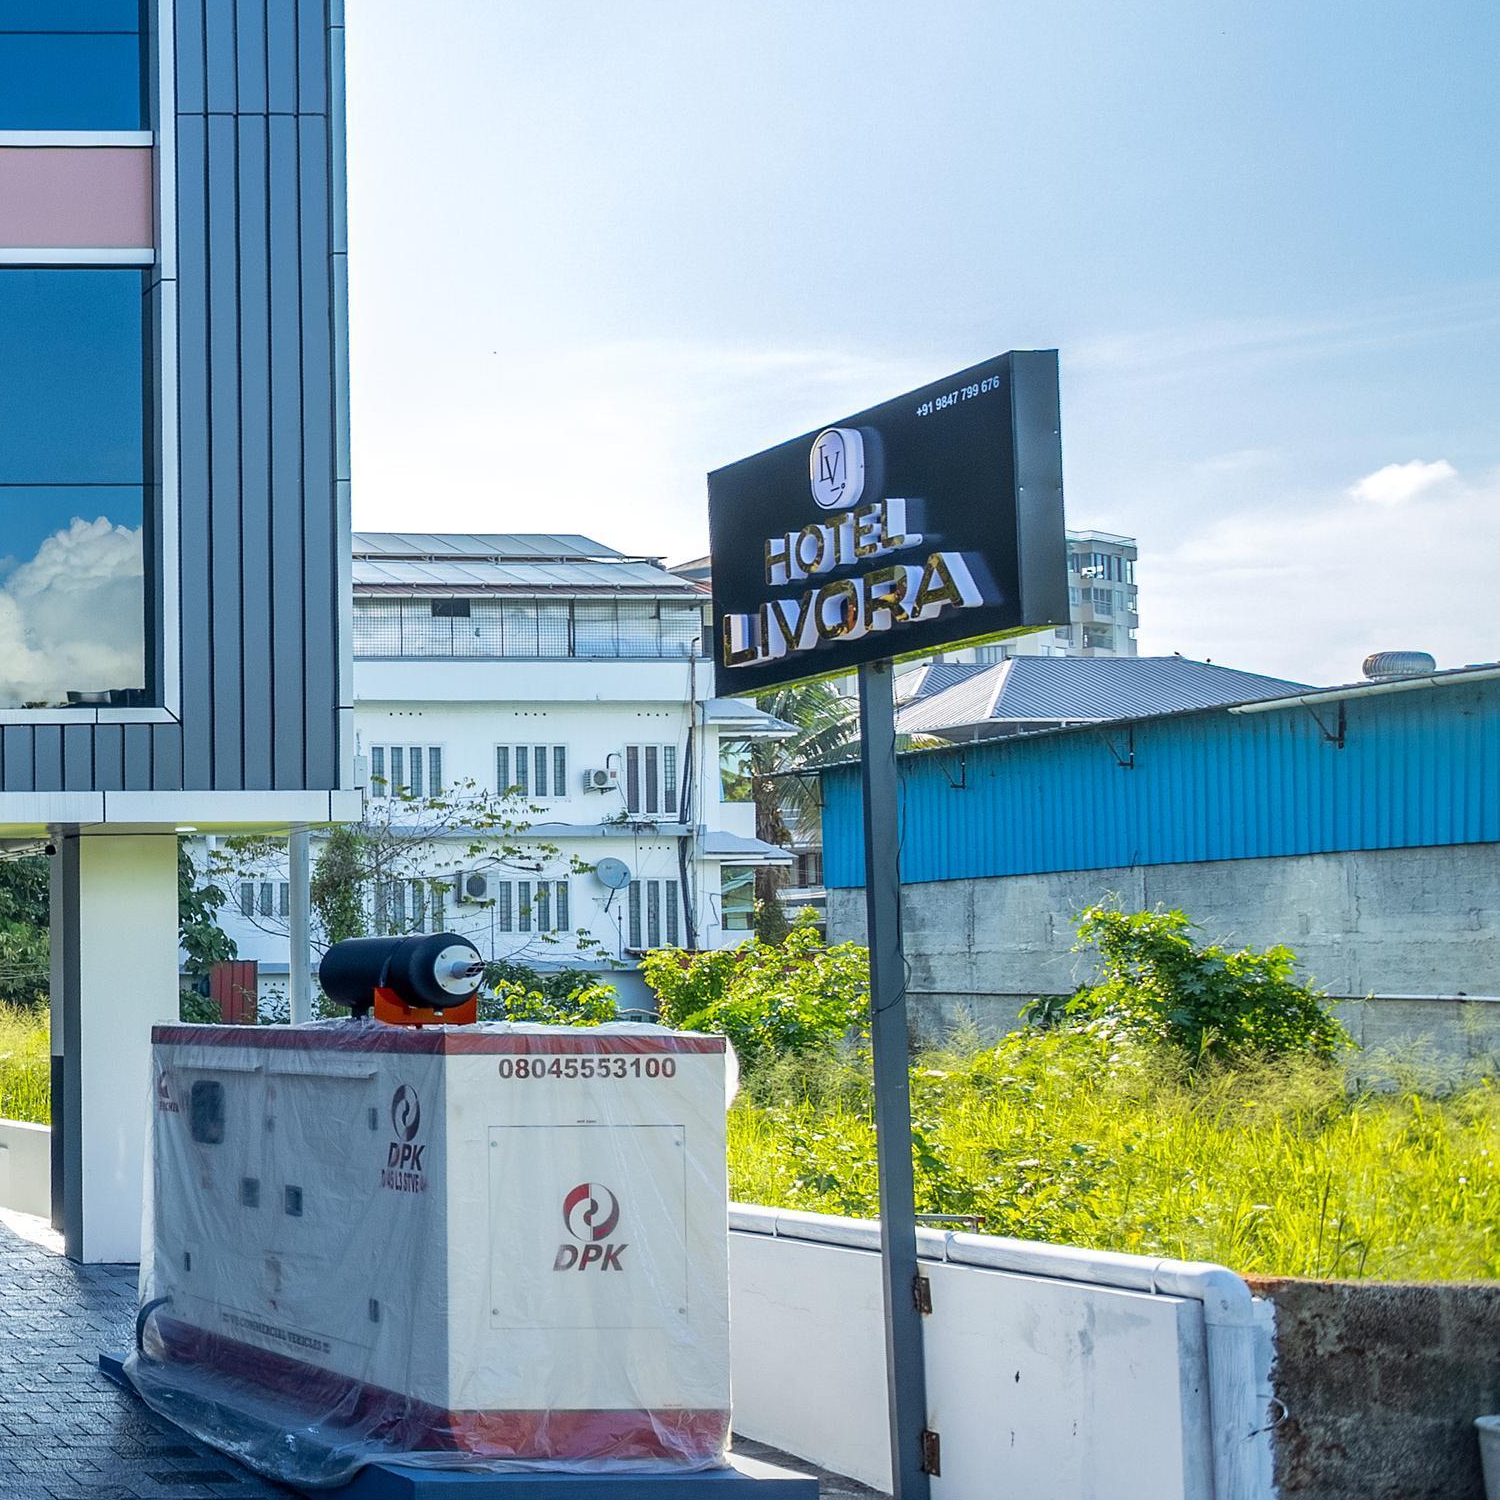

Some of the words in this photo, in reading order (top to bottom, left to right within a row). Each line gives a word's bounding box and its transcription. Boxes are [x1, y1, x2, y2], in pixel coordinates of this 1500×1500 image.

[916, 401, 933, 417] +91
[935, 390, 959, 411] 9847
[961, 383, 979, 401] 799
[981, 375, 1000, 394] 676
[764, 498, 922, 586] HOTEL
[723, 552, 984, 668] LIVORA
[498, 1057, 677, 1079] 08045553100
[387, 1142, 426, 1171] DPK
[553, 1243, 630, 1271] DPK
